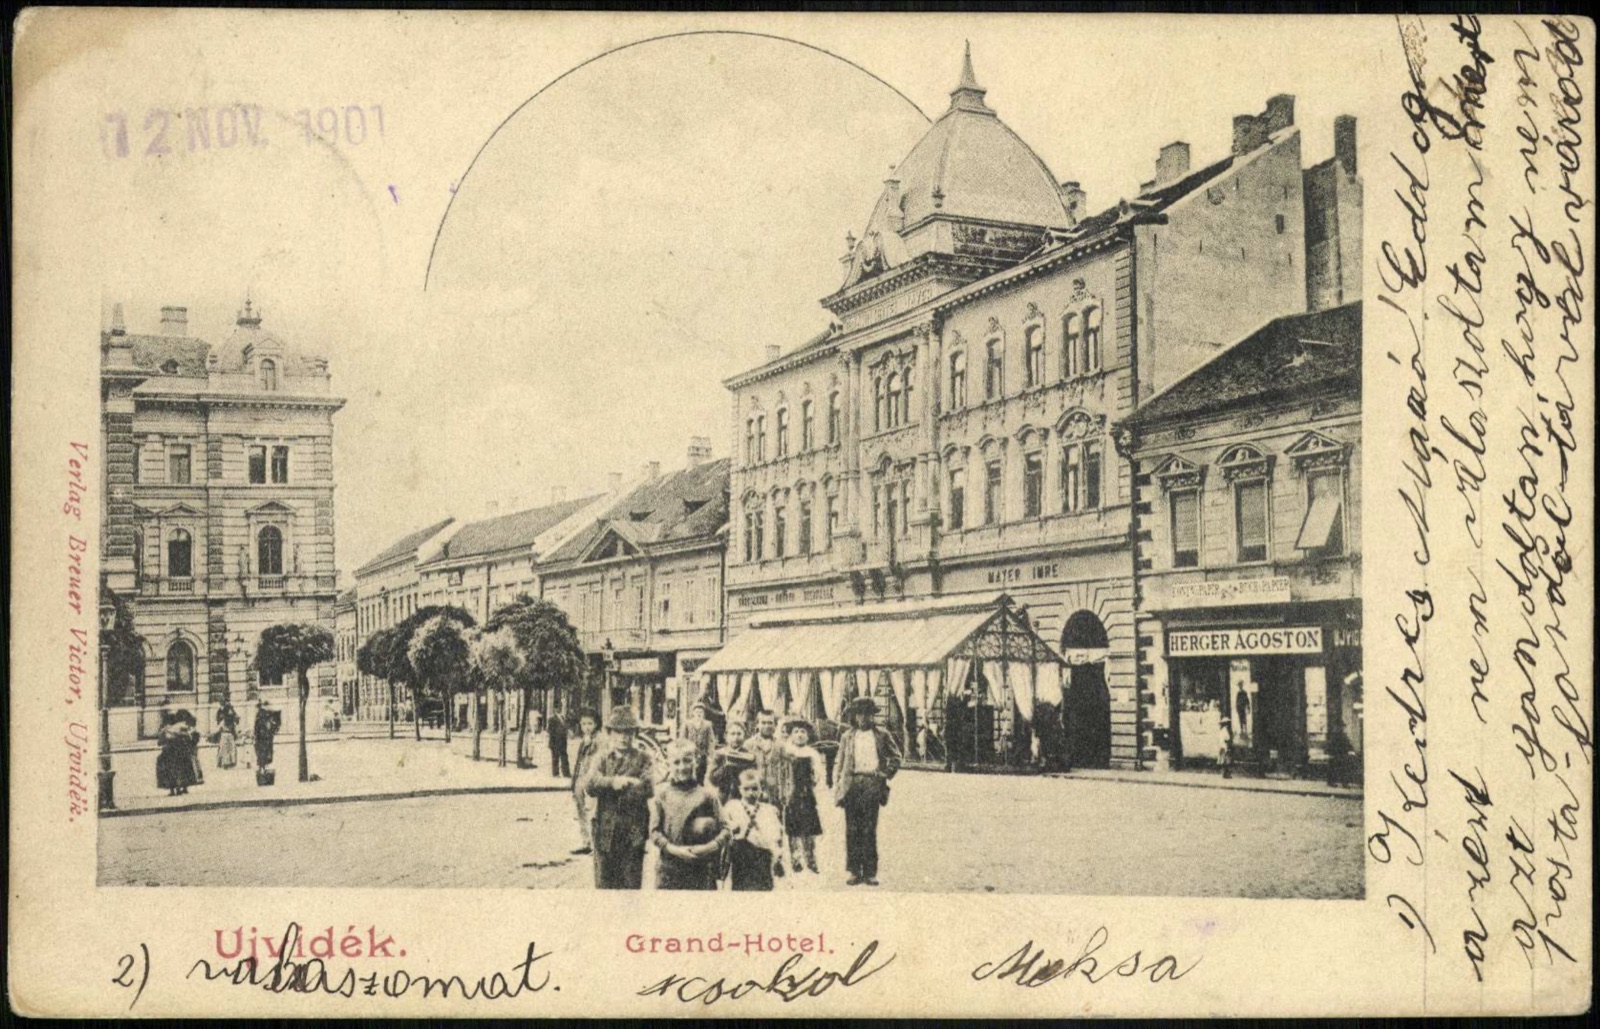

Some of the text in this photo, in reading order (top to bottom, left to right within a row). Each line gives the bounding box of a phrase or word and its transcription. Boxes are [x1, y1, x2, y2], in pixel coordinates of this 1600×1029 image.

[988, 564, 1059, 585] MAYER IMRE
[1170, 634, 1231, 653] HERGER
